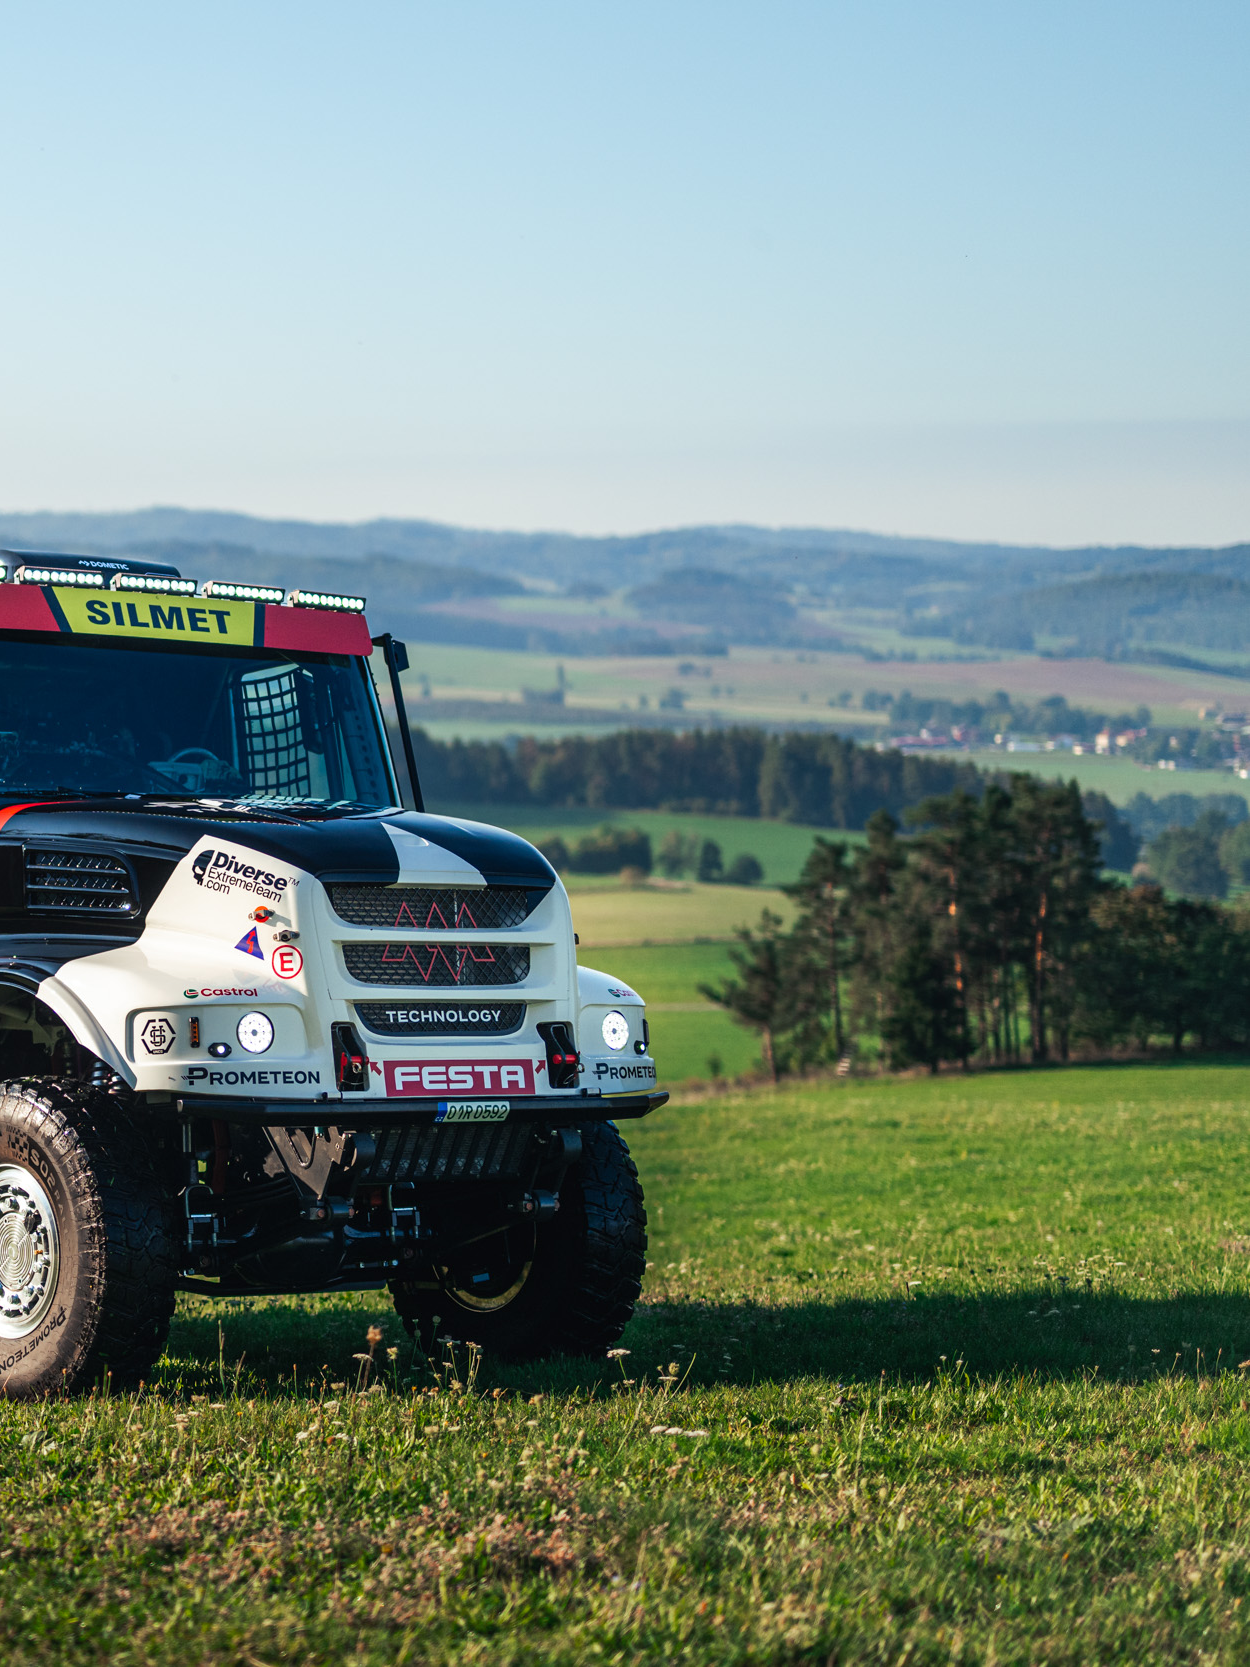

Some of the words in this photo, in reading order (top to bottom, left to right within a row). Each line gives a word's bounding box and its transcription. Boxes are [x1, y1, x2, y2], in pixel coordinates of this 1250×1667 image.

[90, 561, 129, 570] DOMETIC
[86, 599, 232, 635] SILMET
[207, 867, 282, 903] ExtremeTeam
[200, 987, 258, 998] Castrol
[385, 1010, 501, 1023] TECHNOLOGY
[183, 1067, 320, 1086] PROMETEON
[394, 1065, 526, 1091] FESTA
